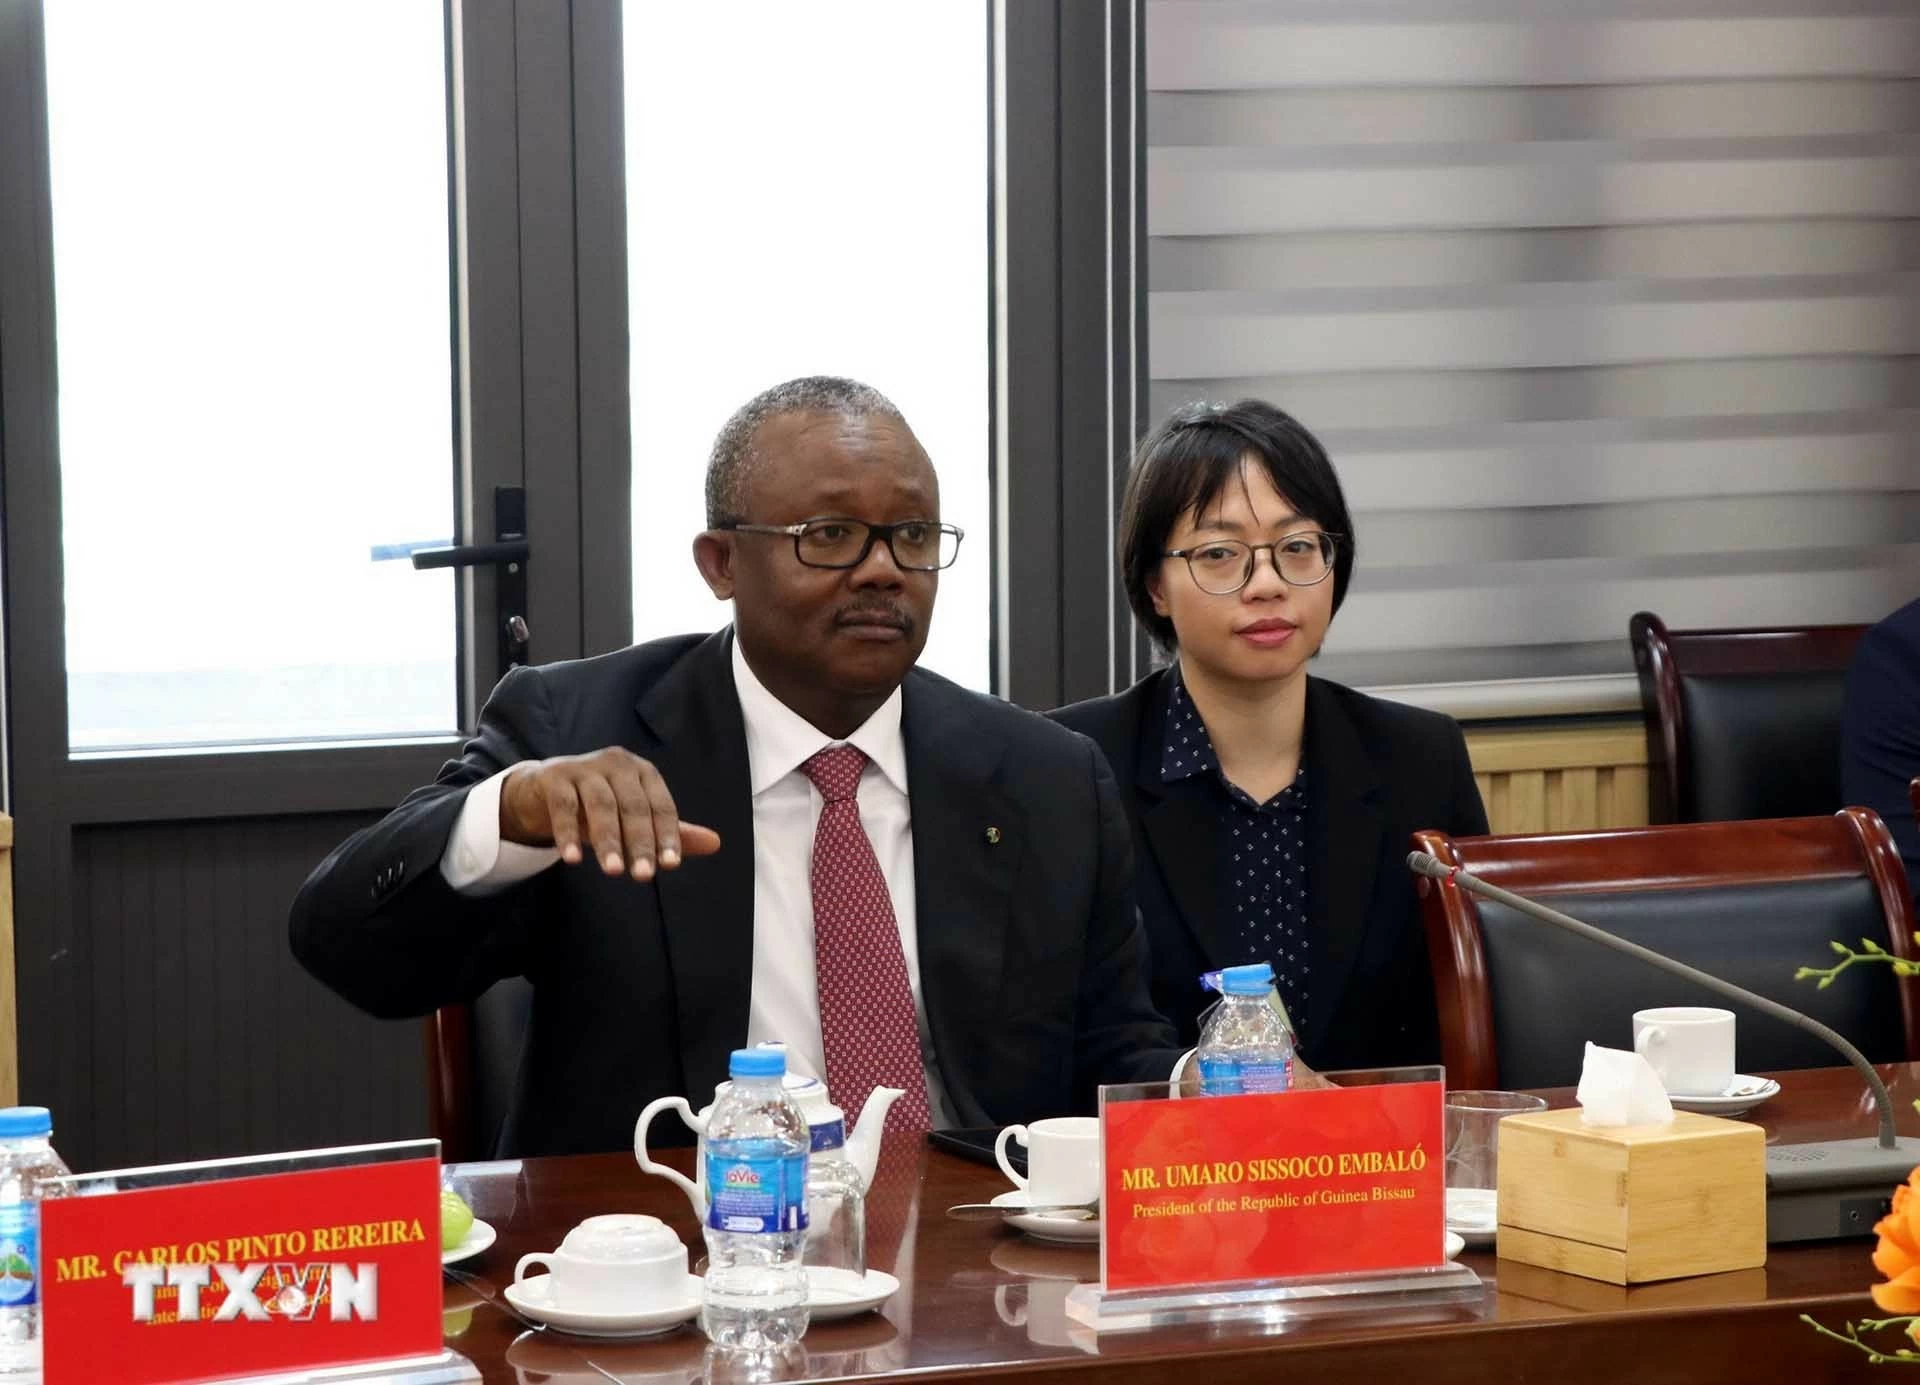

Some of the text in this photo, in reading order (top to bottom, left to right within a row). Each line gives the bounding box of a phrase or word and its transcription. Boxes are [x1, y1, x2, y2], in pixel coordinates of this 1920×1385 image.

[1122, 1142, 1426, 1191] MR. UMARO SISSOCO EMBALÓ
[1133, 1186, 1416, 1219] President of the Republic of Guinea Bissau
[56, 1218, 425, 1283] MR. CARLOS PINTO REREIRA
